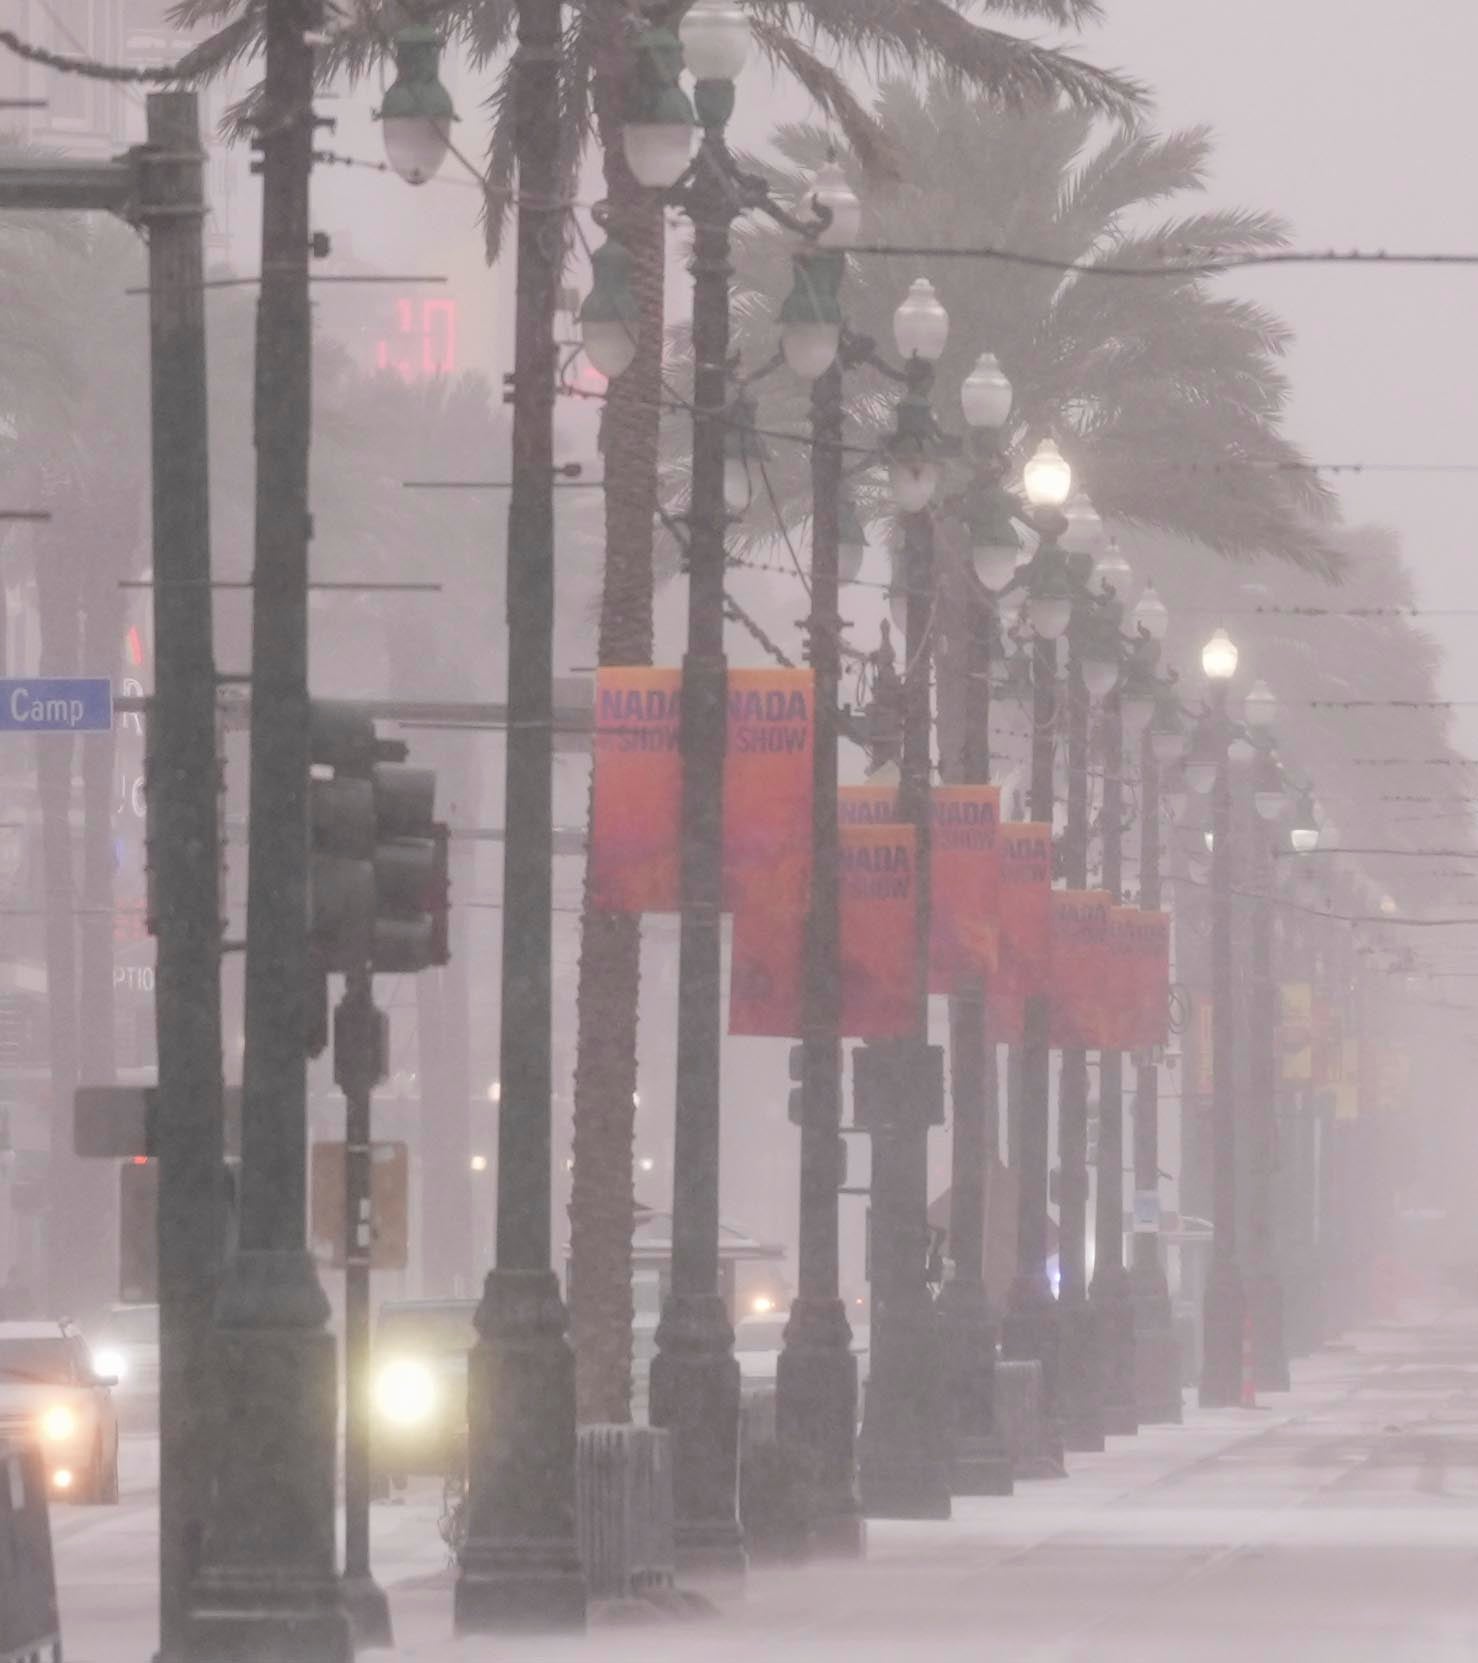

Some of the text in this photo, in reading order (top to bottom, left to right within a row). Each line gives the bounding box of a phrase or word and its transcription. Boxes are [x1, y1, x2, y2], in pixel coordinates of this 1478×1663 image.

[9, 687, 85, 727] Camp
[727, 691, 807, 721] NADA
[736, 727, 808, 753] SHOW
[1003, 840, 1047, 861] ADA
